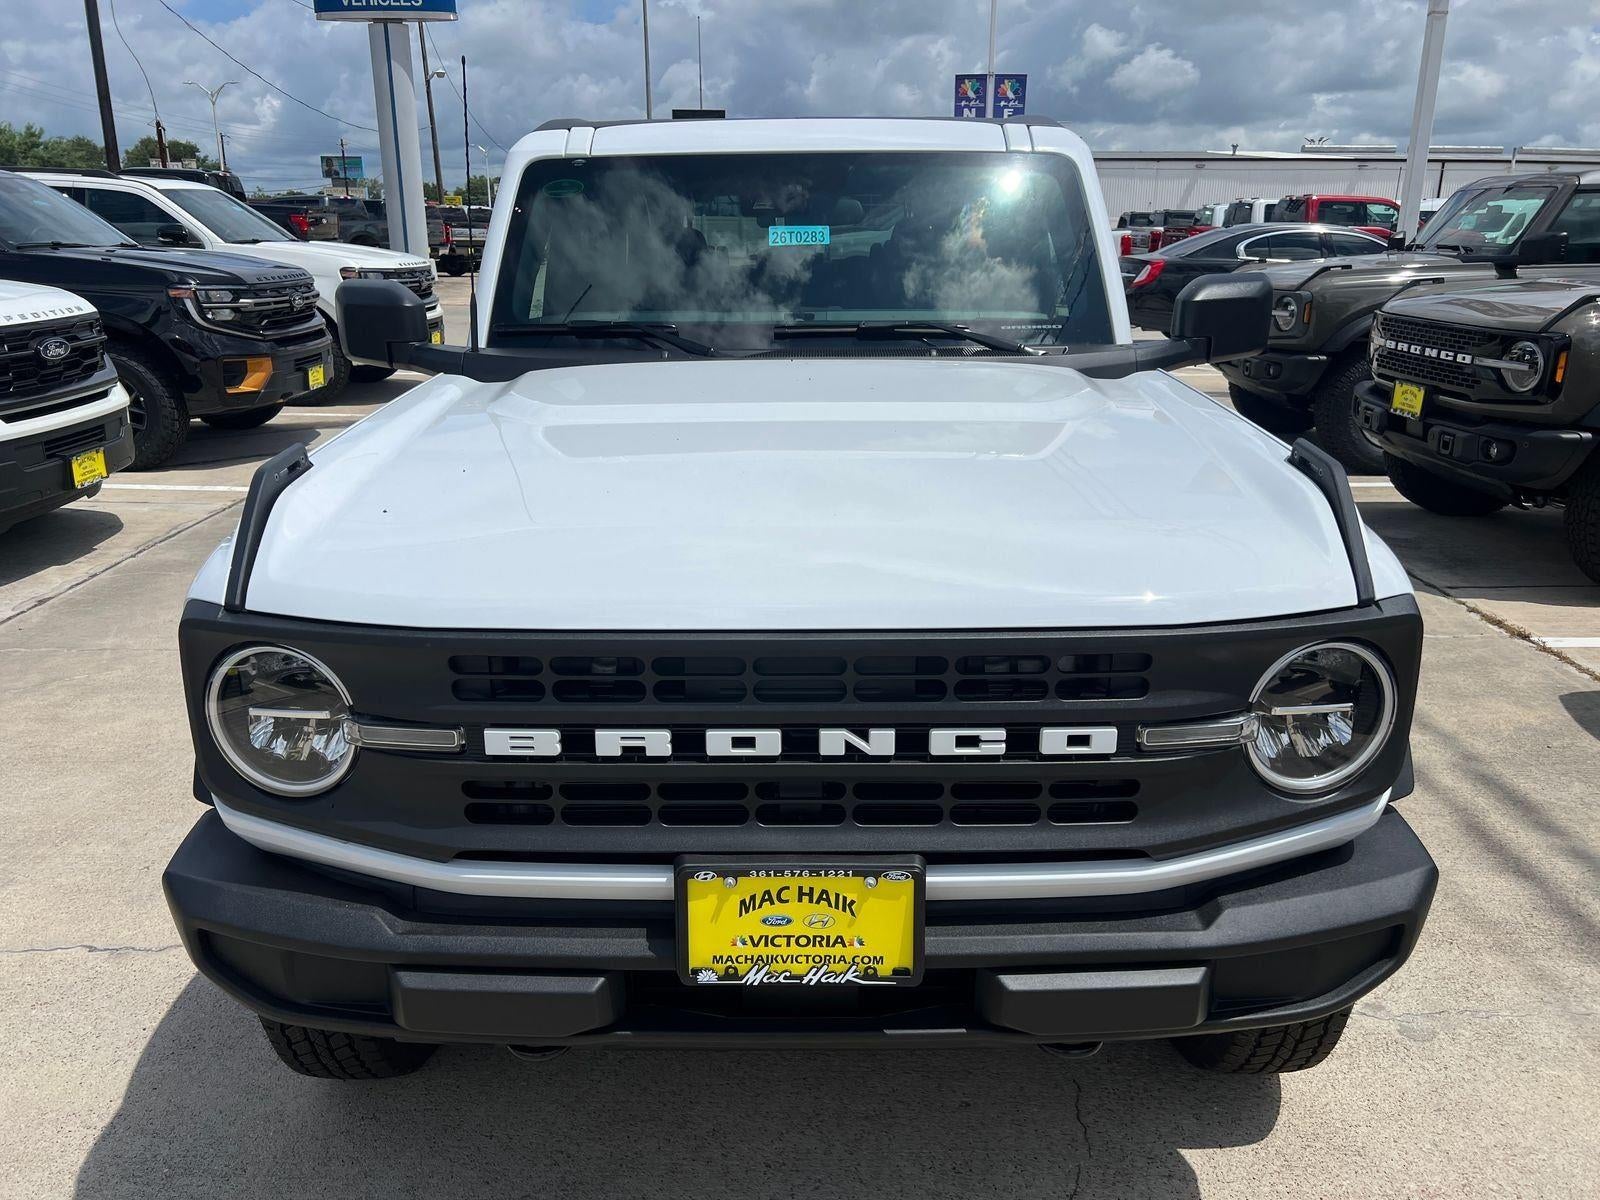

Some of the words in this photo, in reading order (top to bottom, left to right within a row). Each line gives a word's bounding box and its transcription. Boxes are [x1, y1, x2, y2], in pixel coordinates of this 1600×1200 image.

[771, 231, 826, 244] 26T0283
[1385, 339, 1473, 365] BRONCO
[483, 726, 1119, 758] BRONCO
[749, 870, 854, 878] 361-576-1221
[738, 885, 790, 918] MAC
[797, 885, 857, 919] HAIK
[748, 934, 848, 949] VICTORIA
[712, 954, 885, 966] MACHAIKVICTORIA.COM
[740, 964, 797, 986] Mac
[801, 964, 870, 986] Haik
